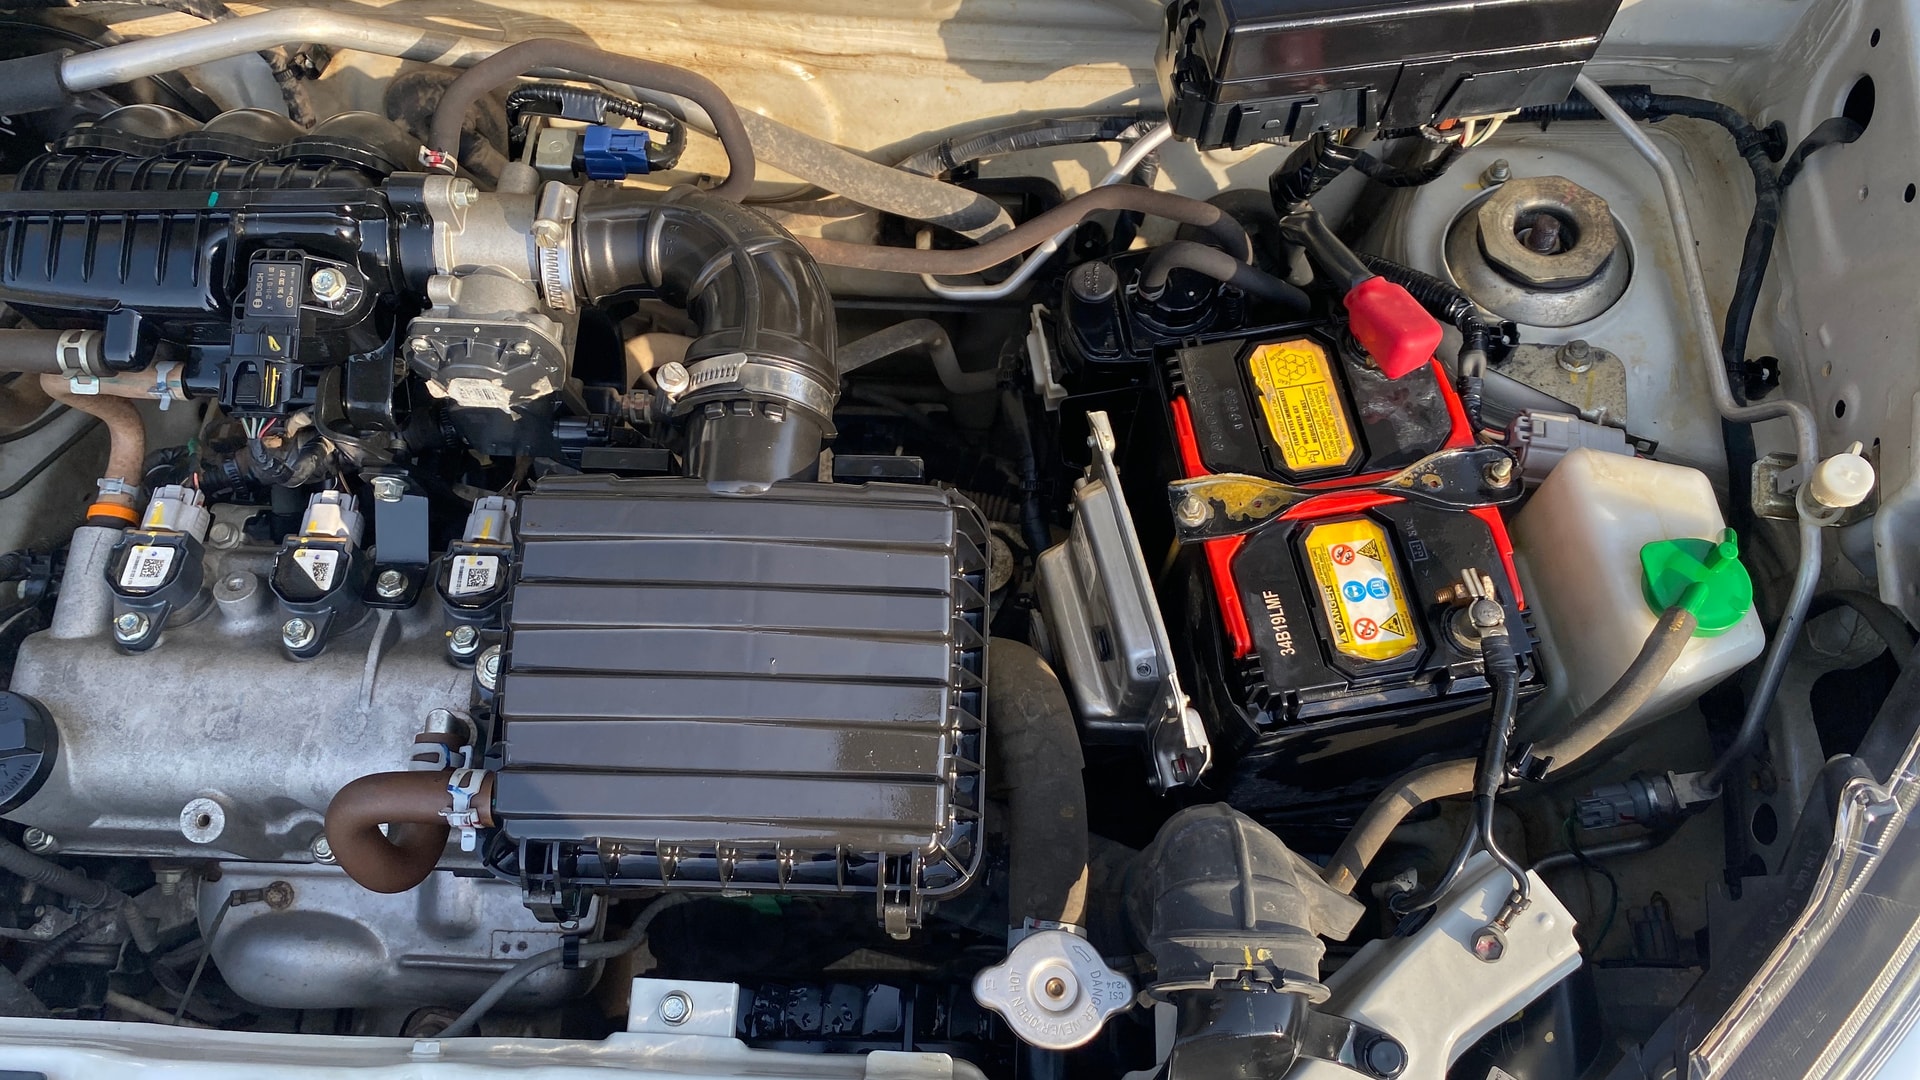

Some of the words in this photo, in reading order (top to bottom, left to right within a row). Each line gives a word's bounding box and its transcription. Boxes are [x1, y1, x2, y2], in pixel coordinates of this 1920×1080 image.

[255, 272, 264, 297] BOSCH
[1324, 585, 1344, 630] DANGER
[1262, 590, 1295, 657] 34B19LMF
[1008, 967, 1022, 993] HOT
[1082, 970, 1103, 1021] DANGER
[1109, 991, 1124, 1000] CSI
[1011, 996, 1041, 1029] OPEN
[1039, 1018, 1081, 1036] NEVER
